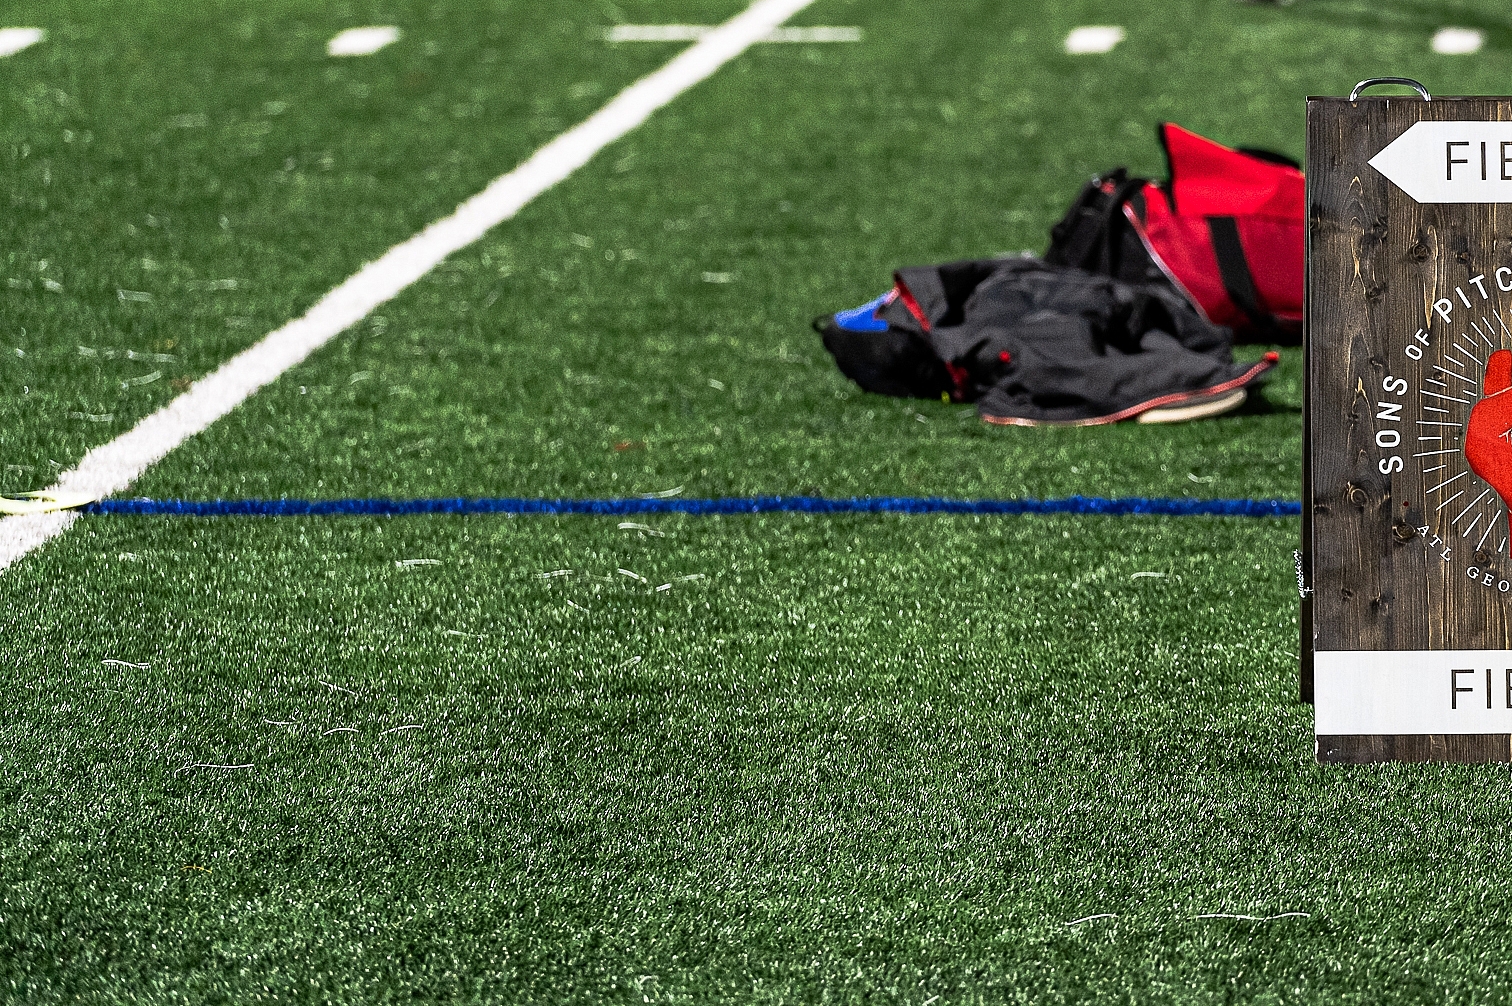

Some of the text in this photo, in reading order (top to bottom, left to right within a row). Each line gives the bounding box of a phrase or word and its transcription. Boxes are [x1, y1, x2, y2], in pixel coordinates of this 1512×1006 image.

[1376, 375, 1408, 475] SONS
[1404, 328, 1431, 362] OF
[1416, 524, 1511, 593] ATL GEO
